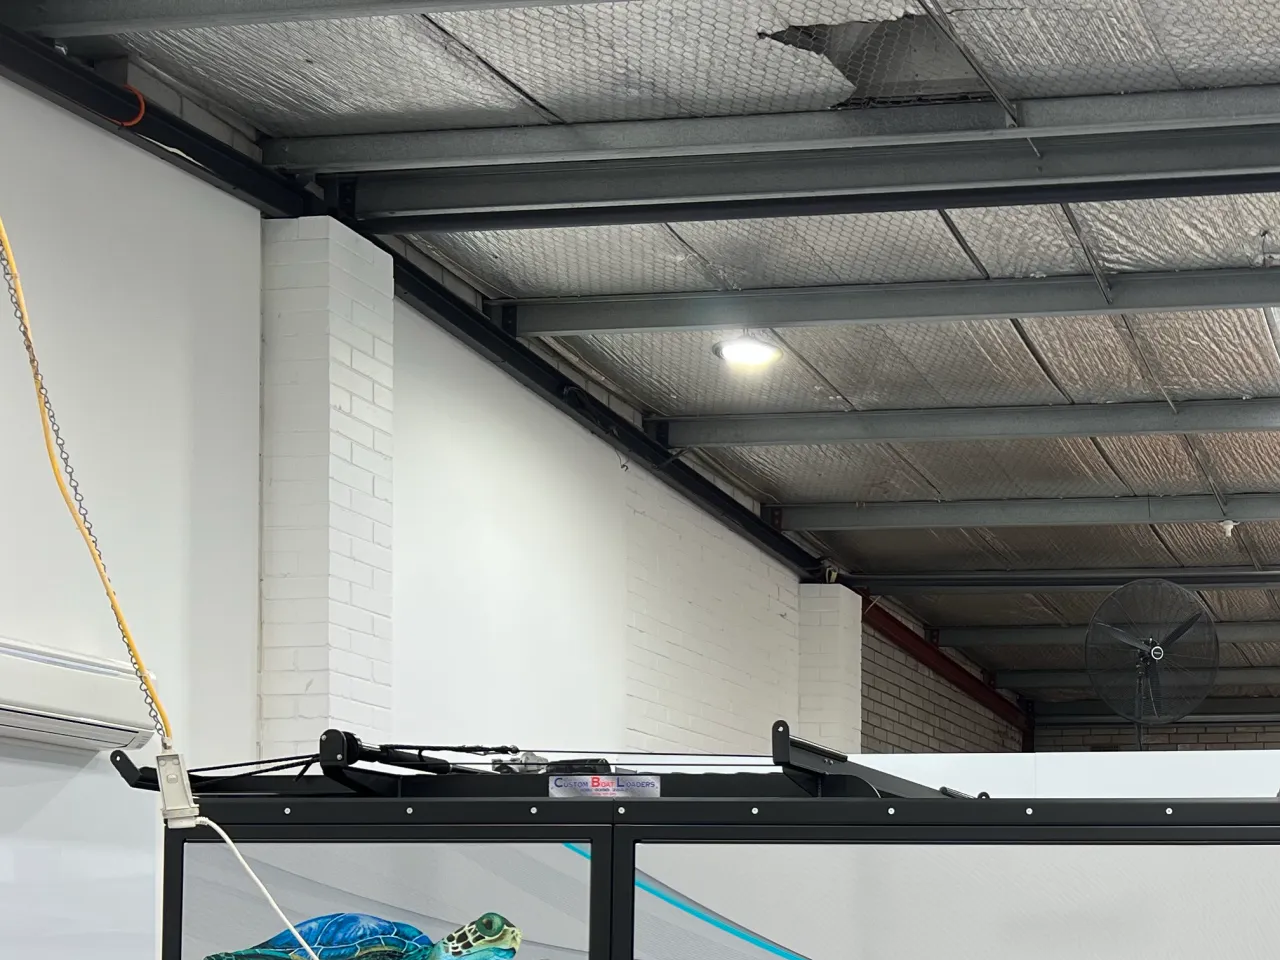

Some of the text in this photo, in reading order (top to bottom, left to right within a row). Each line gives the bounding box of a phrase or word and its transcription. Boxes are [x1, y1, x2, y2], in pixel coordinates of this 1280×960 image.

[554, 776, 656, 788] CUSTOM BOAT LOADERS
